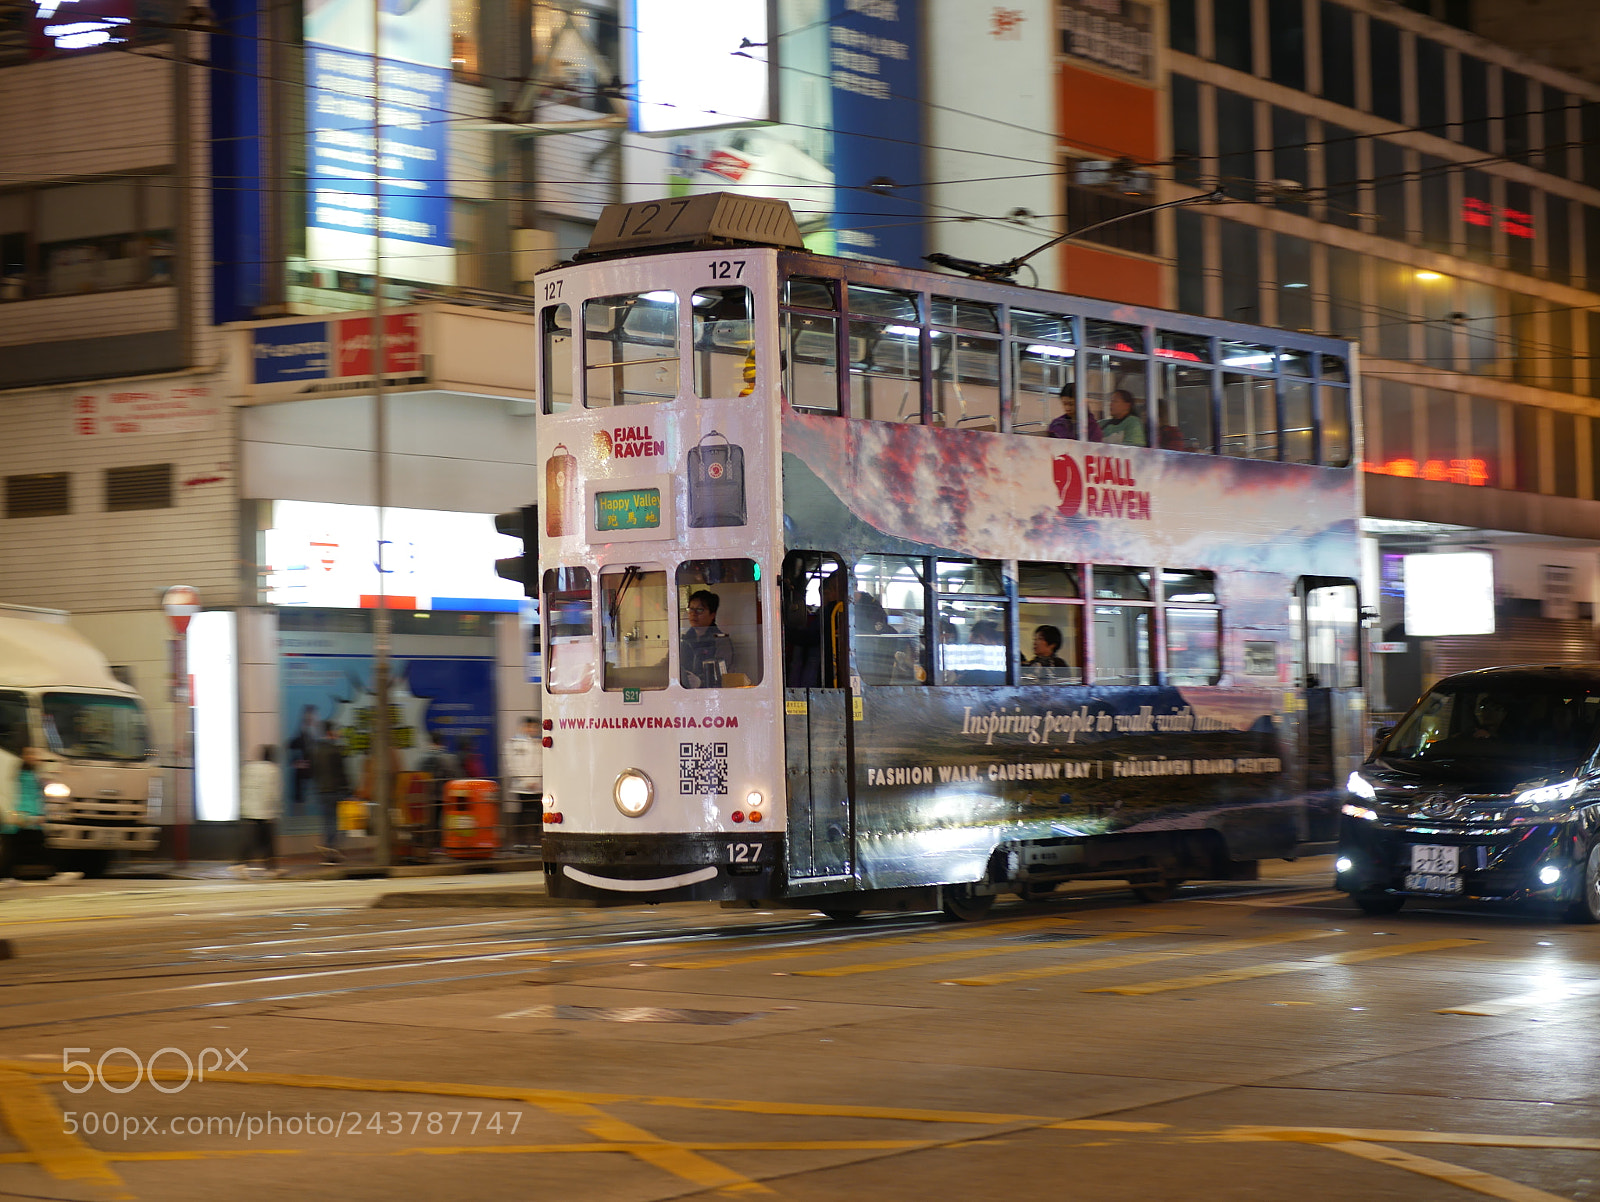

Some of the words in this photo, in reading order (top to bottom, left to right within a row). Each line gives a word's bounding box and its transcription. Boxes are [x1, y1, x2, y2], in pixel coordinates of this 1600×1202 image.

[616, 199, 690, 238] 127
[708, 260, 746, 280] 127
[544, 279, 563, 301] 127
[613, 426, 653, 442] FJÄLL
[614, 440, 665, 459] RÄVEN
[600, 498, 630, 511] Happy
[633, 494, 661, 508] Valley
[625, 690, 639, 700] S21
[559, 716, 739, 730] WWW.FJALLRAVENASIA.COM
[960, 706, 1043, 745] Inspiring
[1041, 706, 1095, 745] people
[1095, 710, 1113, 732] to
[867, 766, 934, 787] FASHION
[937, 764, 984, 784] WALK,
[988, 762, 1061, 781] CAUSEWAY
[1063, 761, 1091, 779] BAY
[726, 843, 763, 863] 127
